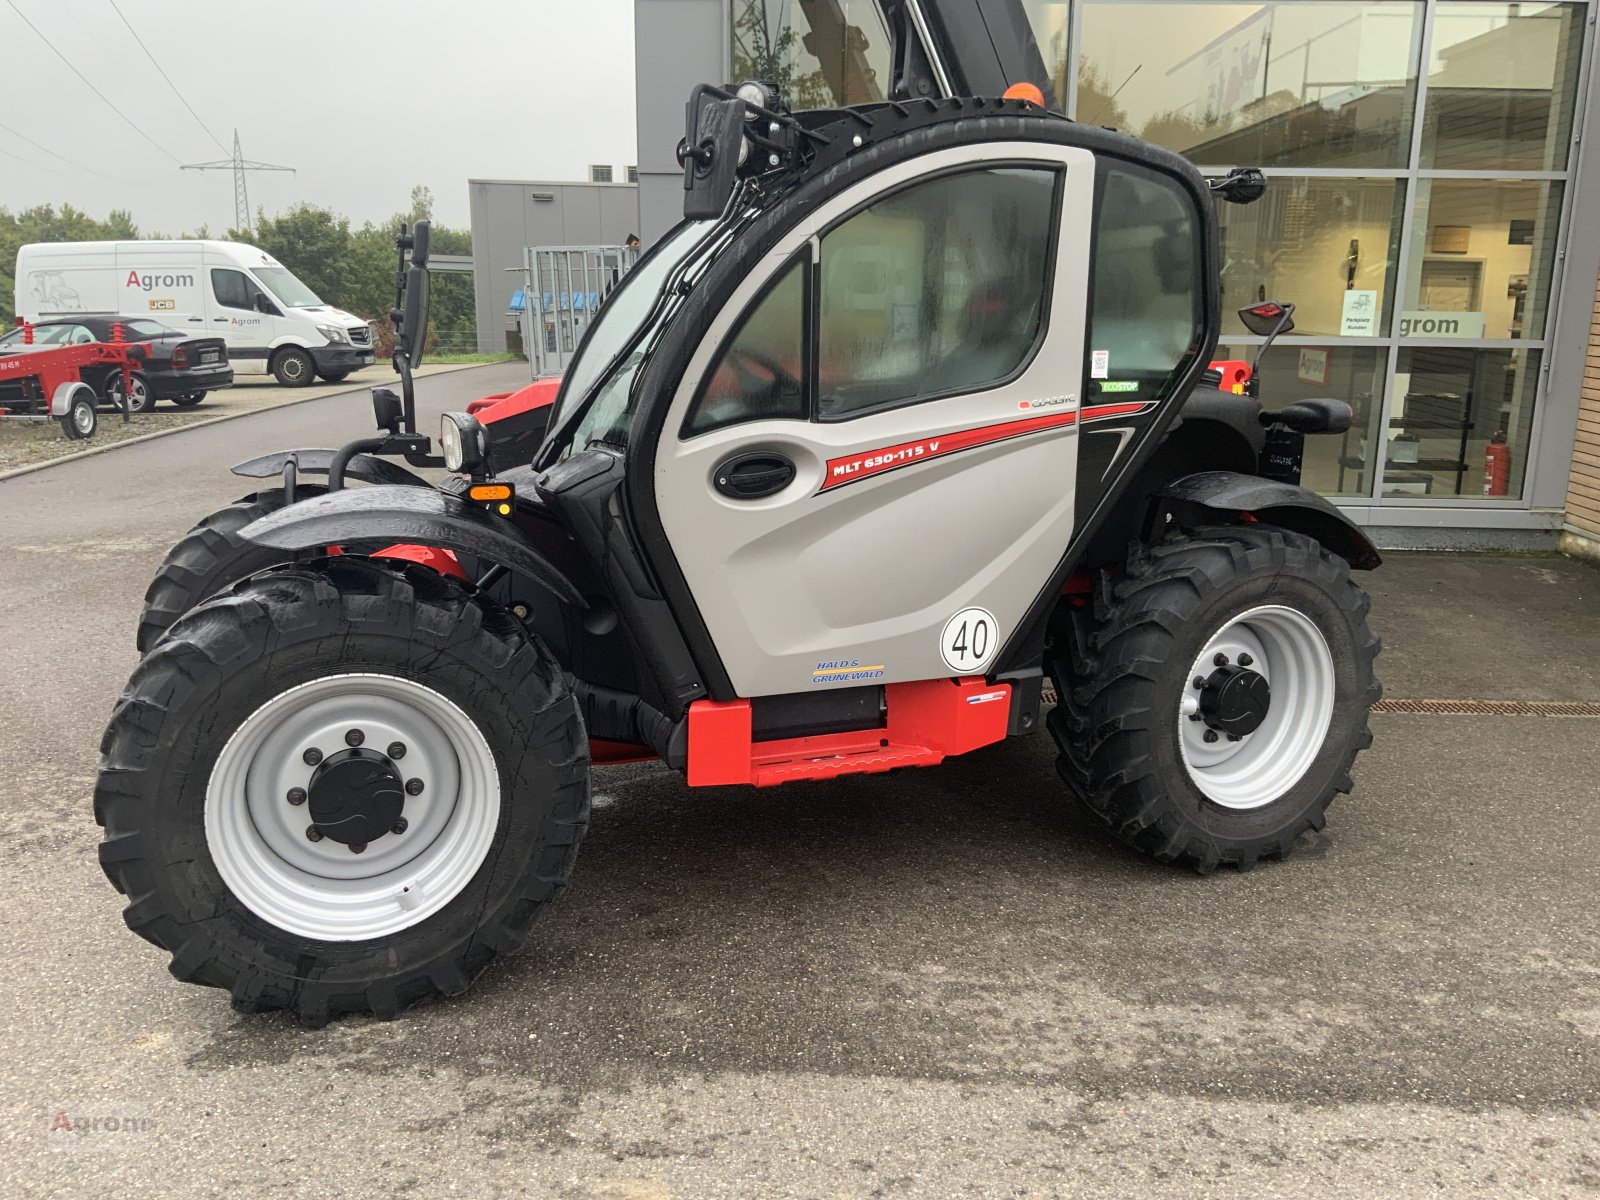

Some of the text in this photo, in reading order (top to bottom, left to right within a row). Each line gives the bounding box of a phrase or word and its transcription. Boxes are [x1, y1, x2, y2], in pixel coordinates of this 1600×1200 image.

[126, 271, 194, 292] Agrom
[150, 301, 174, 309] JCB
[231, 317, 260, 327] Agrom
[1400, 317, 1459, 337] grom
[1103, 382, 1138, 392] ECOSTOP
[1031, 394, 1076, 408] CLASSIC
[833, 441, 940, 477] MLT 630-115 V
[952, 619, 988, 661] 40
[816, 659, 859, 670] HALD &
